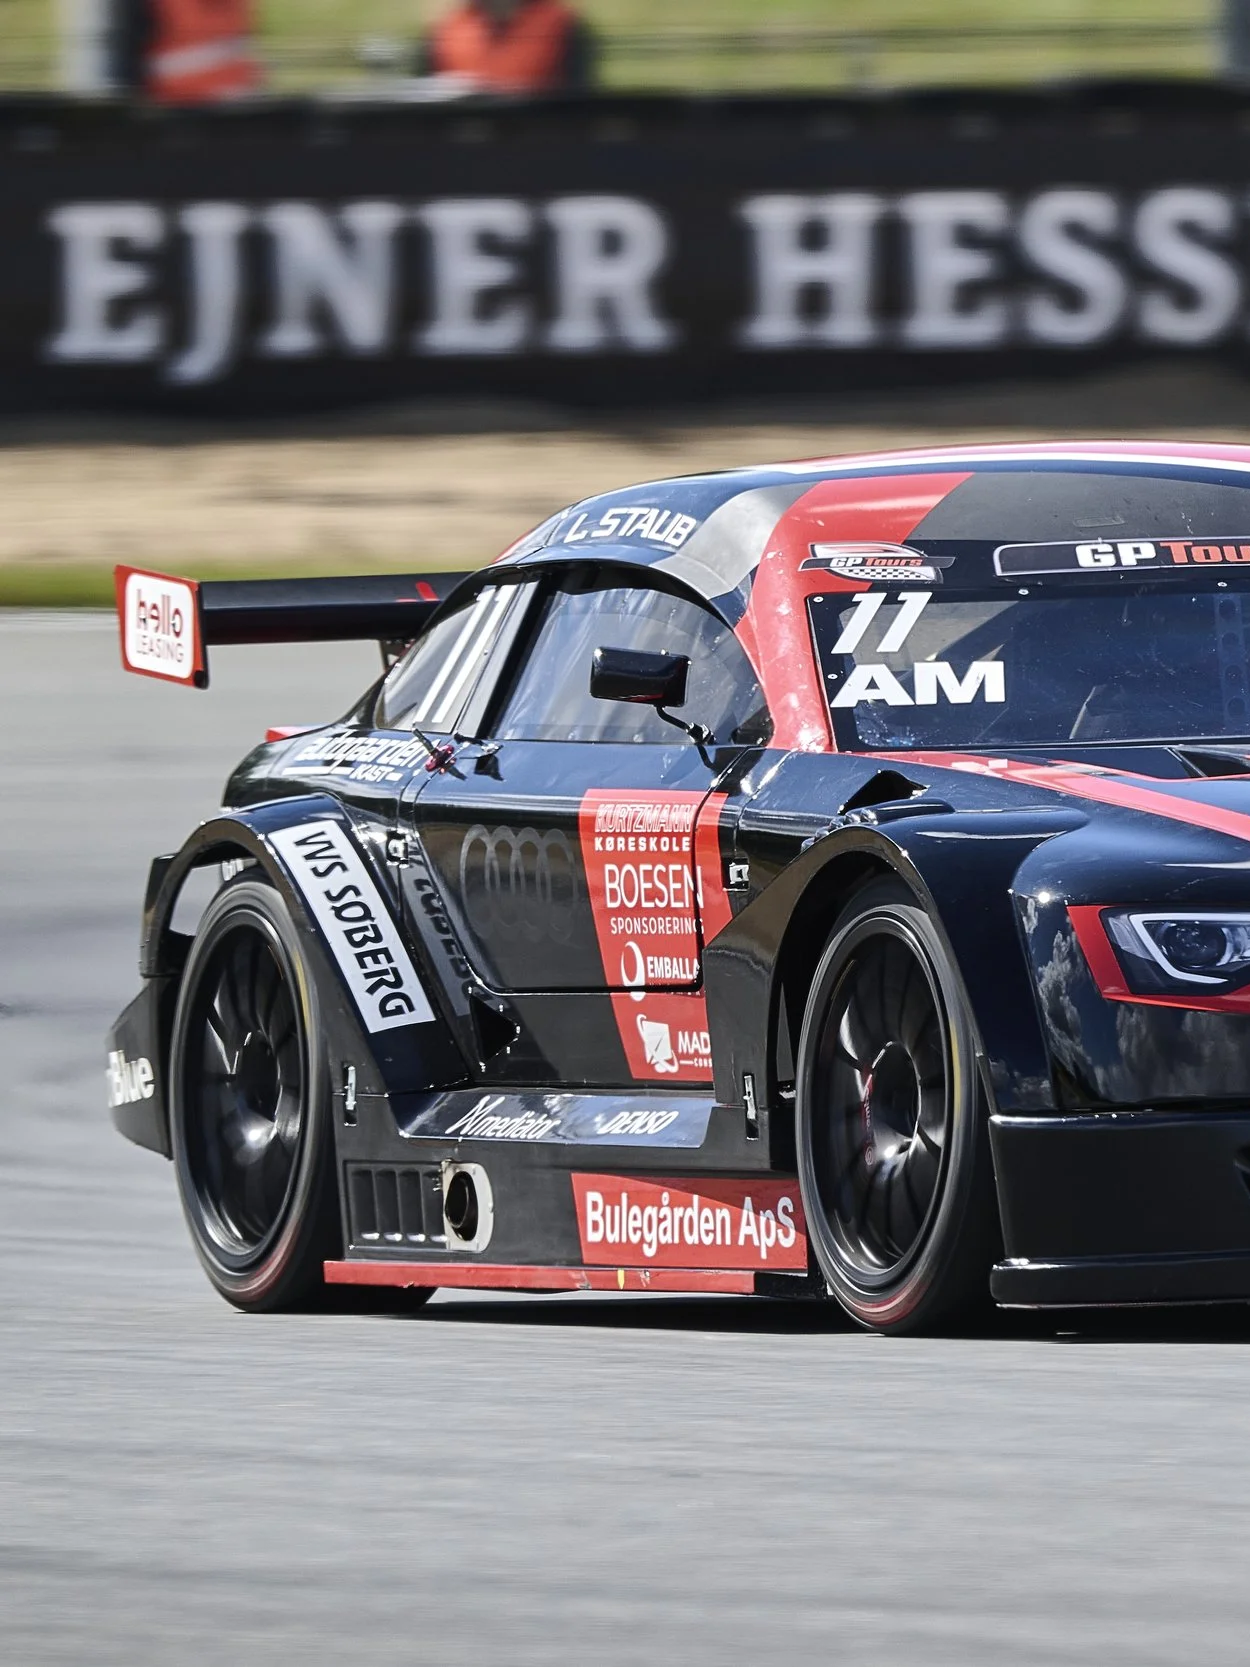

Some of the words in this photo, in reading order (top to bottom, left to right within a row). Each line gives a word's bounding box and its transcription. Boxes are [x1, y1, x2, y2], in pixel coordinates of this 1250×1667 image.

[42, 196, 672, 385] EJNER
[591, 507, 697, 547] STAUB
[829, 556, 863, 568] GP
[864, 556, 924, 568] Tours
[1076, 541, 1157, 568] GP
[136, 588, 184, 638] hello
[831, 591, 933, 655] 11
[135, 633, 185, 663] LEASING
[413, 584, 519, 724] 11
[830, 660, 1006, 708] AM
[349, 763, 395, 782] KAST
[594, 803, 699, 833] KURTZMANN
[594, 836, 691, 852] KØRESKOLE
[604, 863, 705, 909] BOESEN
[294, 830, 349, 878] VVS
[322, 884, 417, 1019] SØBERG
[610, 916, 705, 935] SPONSORERING
[677, 1030, 712, 1055] MAD
[107, 1049, 155, 1108] Blue
[597, 1110, 680, 1135] DENSO
[585, 1190, 732, 1258] Bulegården
[737, 1196, 797, 1260] ApS
